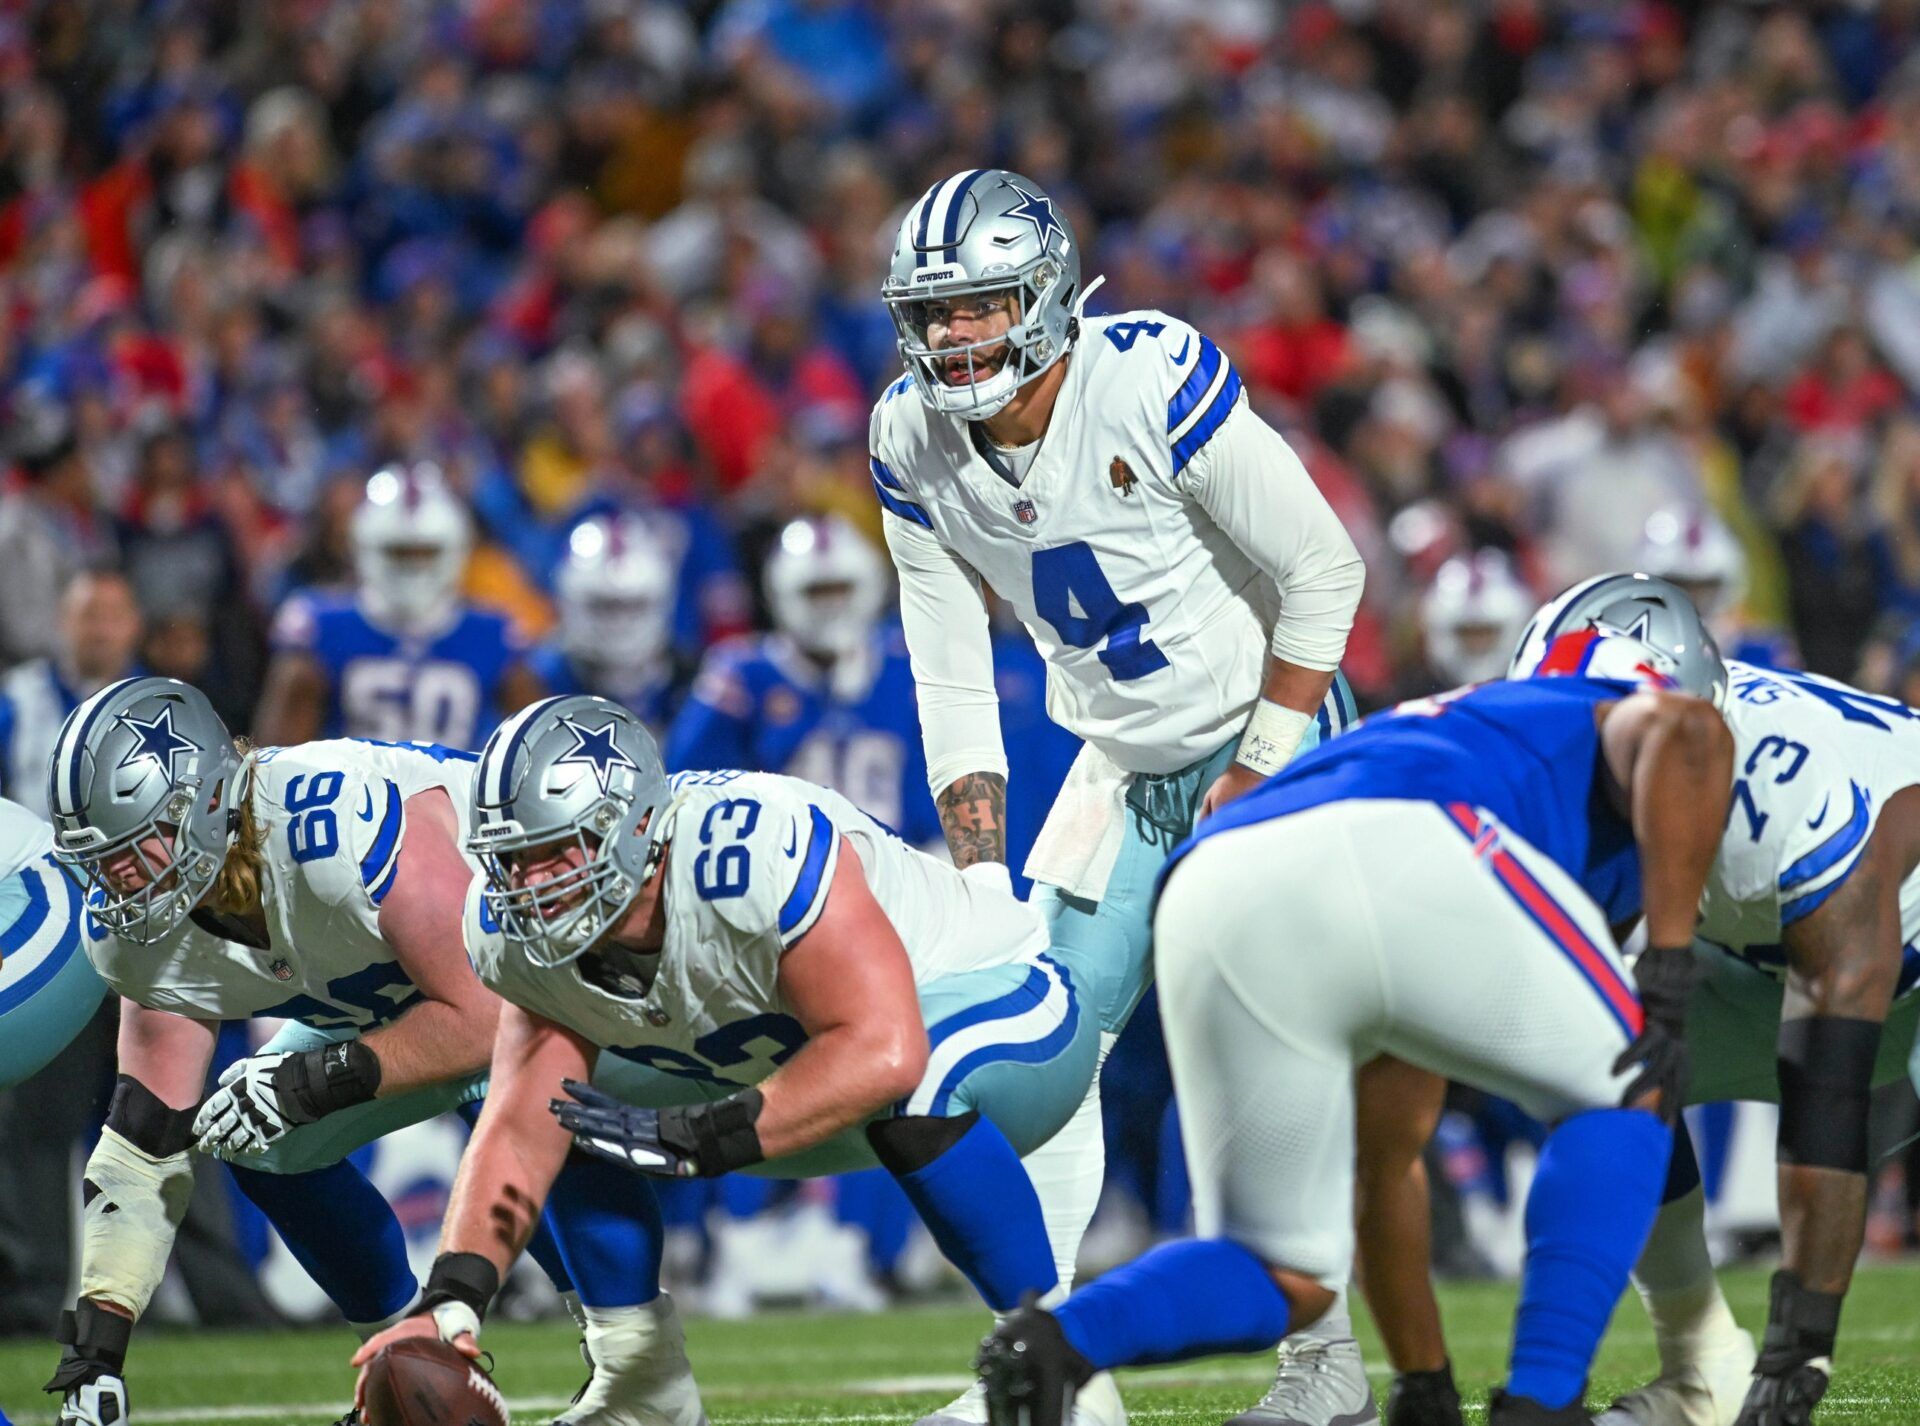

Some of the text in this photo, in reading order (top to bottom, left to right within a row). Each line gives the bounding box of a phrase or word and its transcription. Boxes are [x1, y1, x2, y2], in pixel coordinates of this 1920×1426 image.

[916, 270, 954, 283] COWBOYS
[1103, 319, 1168, 353] 4
[1032, 540, 1171, 682] 4
[284, 770, 346, 865] 66
[1722, 735, 1810, 843] 73
[694, 797, 762, 901] 63
